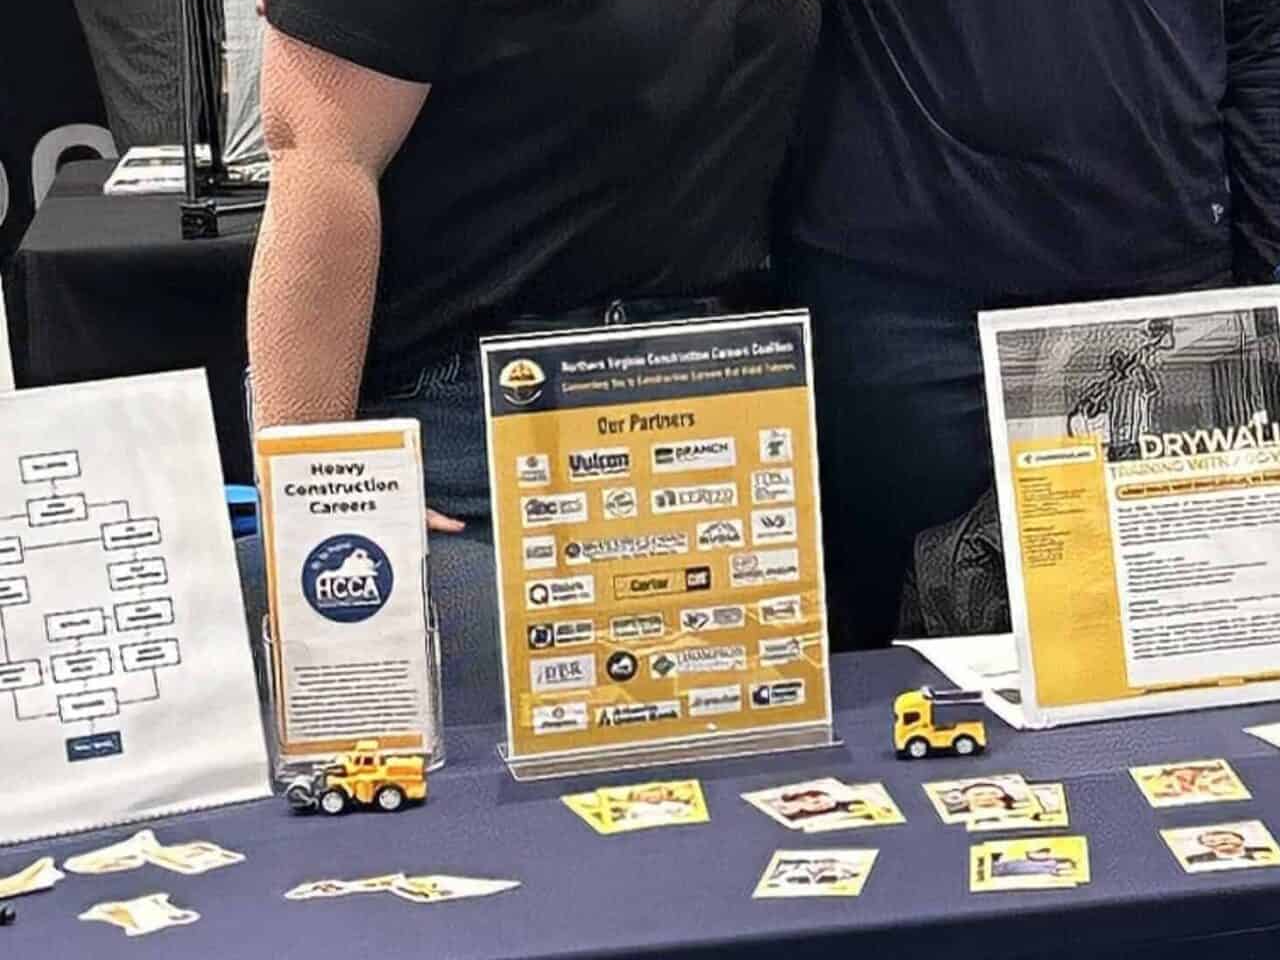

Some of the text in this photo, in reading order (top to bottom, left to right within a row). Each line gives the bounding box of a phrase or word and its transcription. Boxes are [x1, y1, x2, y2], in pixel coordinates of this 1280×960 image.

[597, 411, 696, 435] Our Partners
[310, 461, 366, 478] Heavy
[568, 452, 630, 472] Vulcan
[284, 478, 400, 498] Construction
[309, 499, 377, 515] Careers
[315, 576, 381, 601] HCCA
